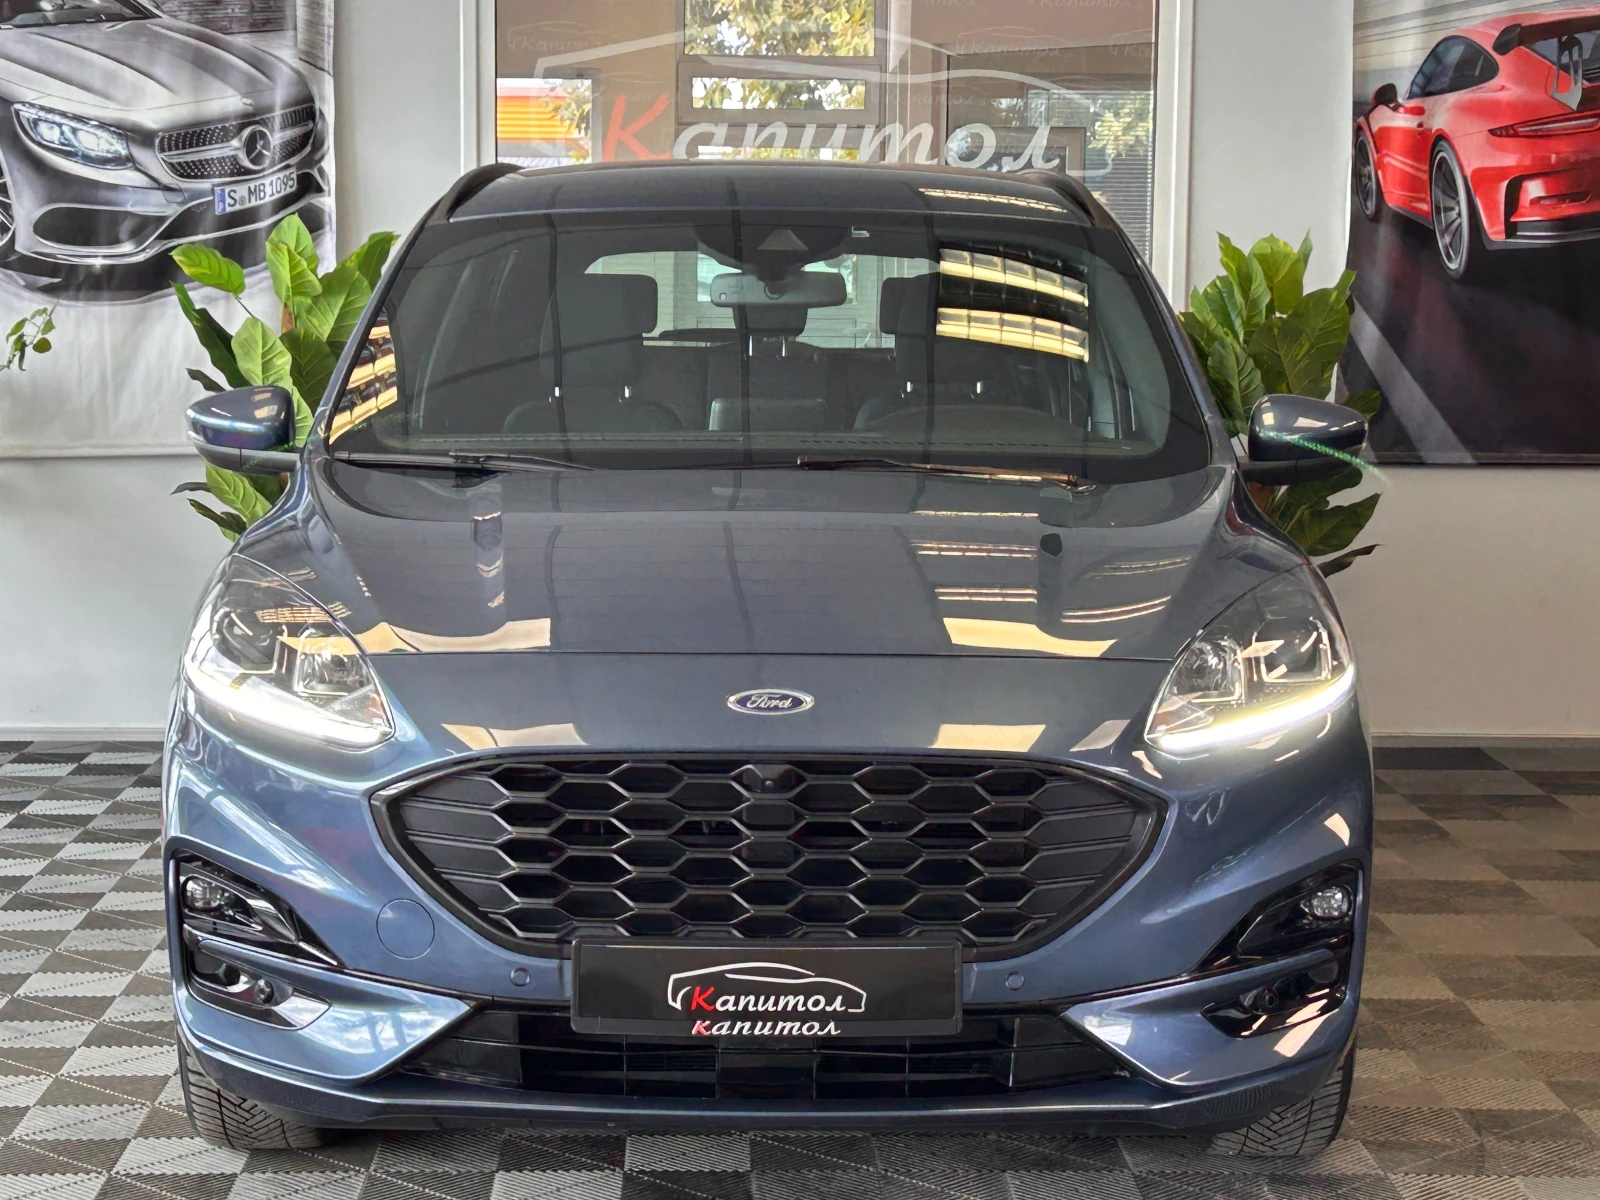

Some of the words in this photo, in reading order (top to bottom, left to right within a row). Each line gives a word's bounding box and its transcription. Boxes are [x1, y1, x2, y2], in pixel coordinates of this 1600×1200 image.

[227, 189, 238, 208] S
[247, 182, 267, 204] MB
[268, 171, 296, 198] 1095
[746, 693, 793, 708] Ford
[690, 985, 846, 1012] Капитол
